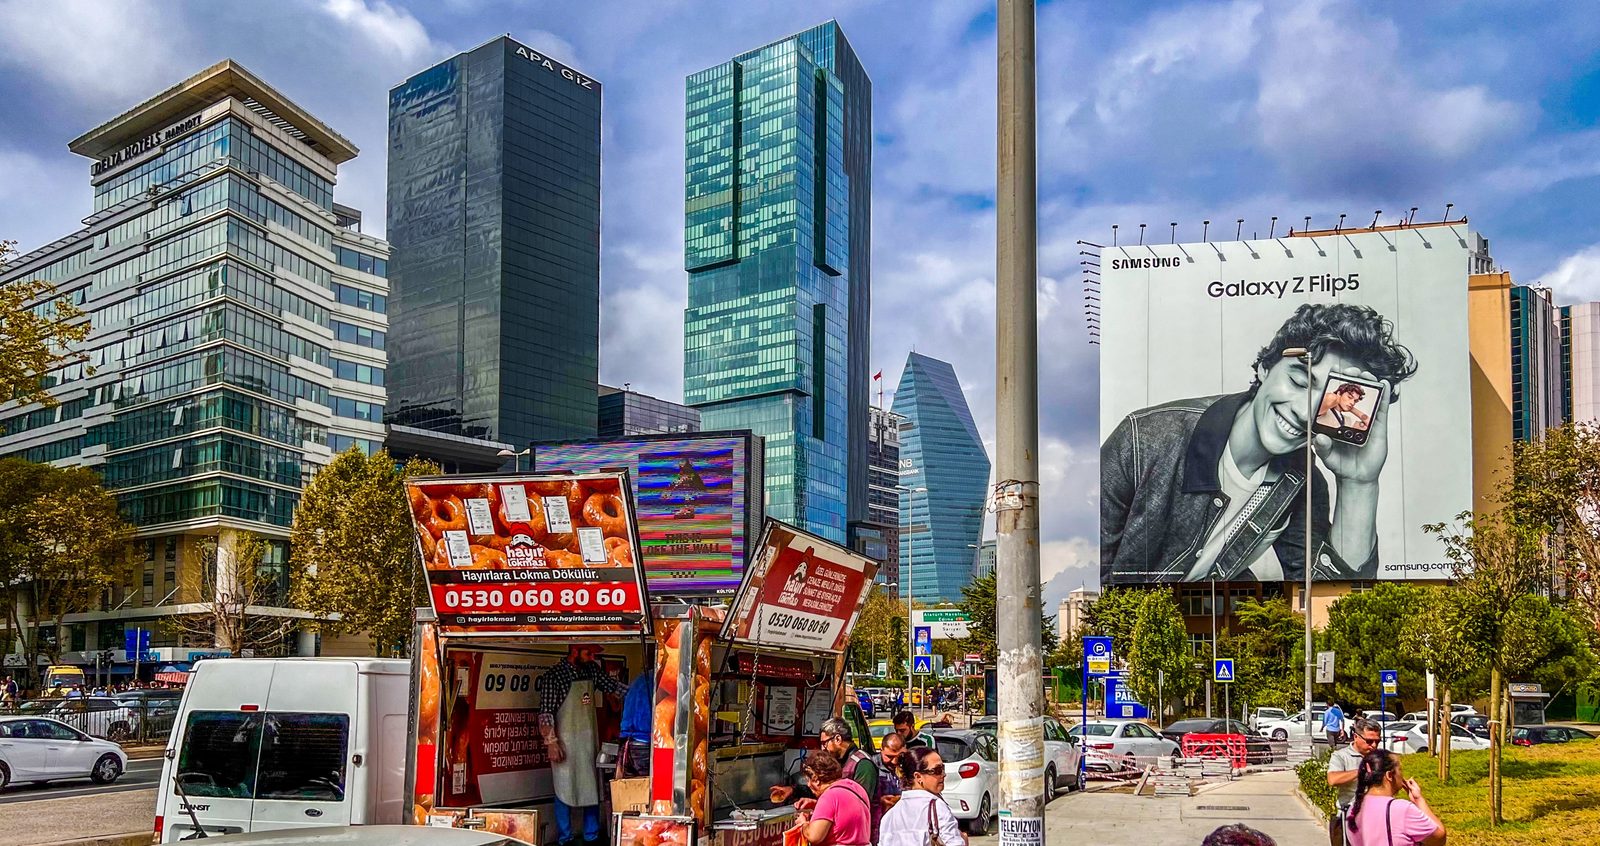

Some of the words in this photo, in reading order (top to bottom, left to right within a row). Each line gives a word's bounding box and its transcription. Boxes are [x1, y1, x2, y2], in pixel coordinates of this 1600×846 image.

[516, 46, 554, 71] APA
[94, 150, 124, 175] DELTA
[124, 132, 161, 160] HOTELS
[164, 115, 202, 140] MARRIOTT
[1112, 256, 1181, 270] SAMSUNG
[1207, 279, 1289, 298] Galaxy
[1292, 276, 1304, 293] Z
[1309, 273, 1360, 297] Flip5
[899, 458, 913, 469] NB
[505, 546, 544, 562] hayır
[461, 570, 511, 582] Hayırlara
[512, 569, 550, 580] Lokma
[552, 568, 599, 580] Dökülür.
[445, 589, 504, 607] 0530
[509, 588, 554, 607] 060
[560, 588, 590, 606] 80
[596, 587, 626, 605] 60
[768, 612, 793, 628] 0530
[791, 617, 809, 631] 060
[807, 619, 820, 633] 80
[484, 674, 506, 692] 60
[510, 674, 531, 692] 80
[1000, 818, 1041, 832] TELEVİZYON
